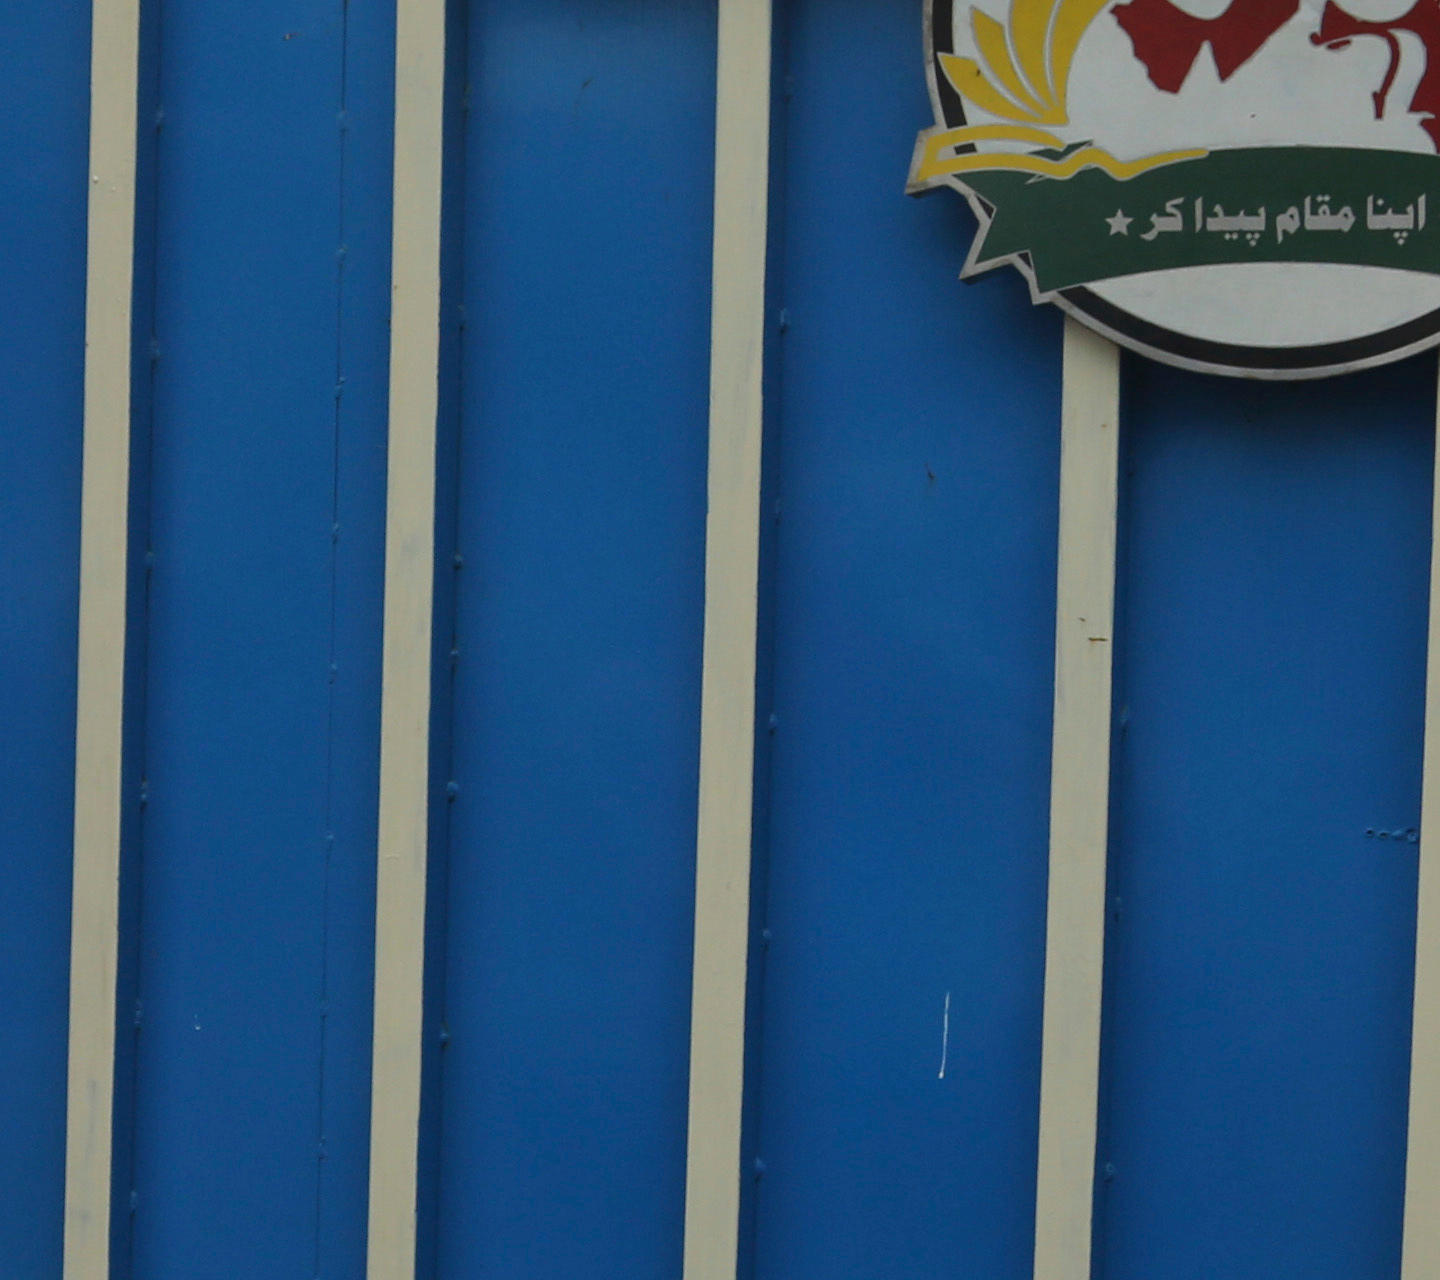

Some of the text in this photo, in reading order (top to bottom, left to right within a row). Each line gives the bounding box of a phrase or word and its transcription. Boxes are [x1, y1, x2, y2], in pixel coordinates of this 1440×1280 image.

[1139, 192, 1426, 247] اپنا مقام پیدا کر
